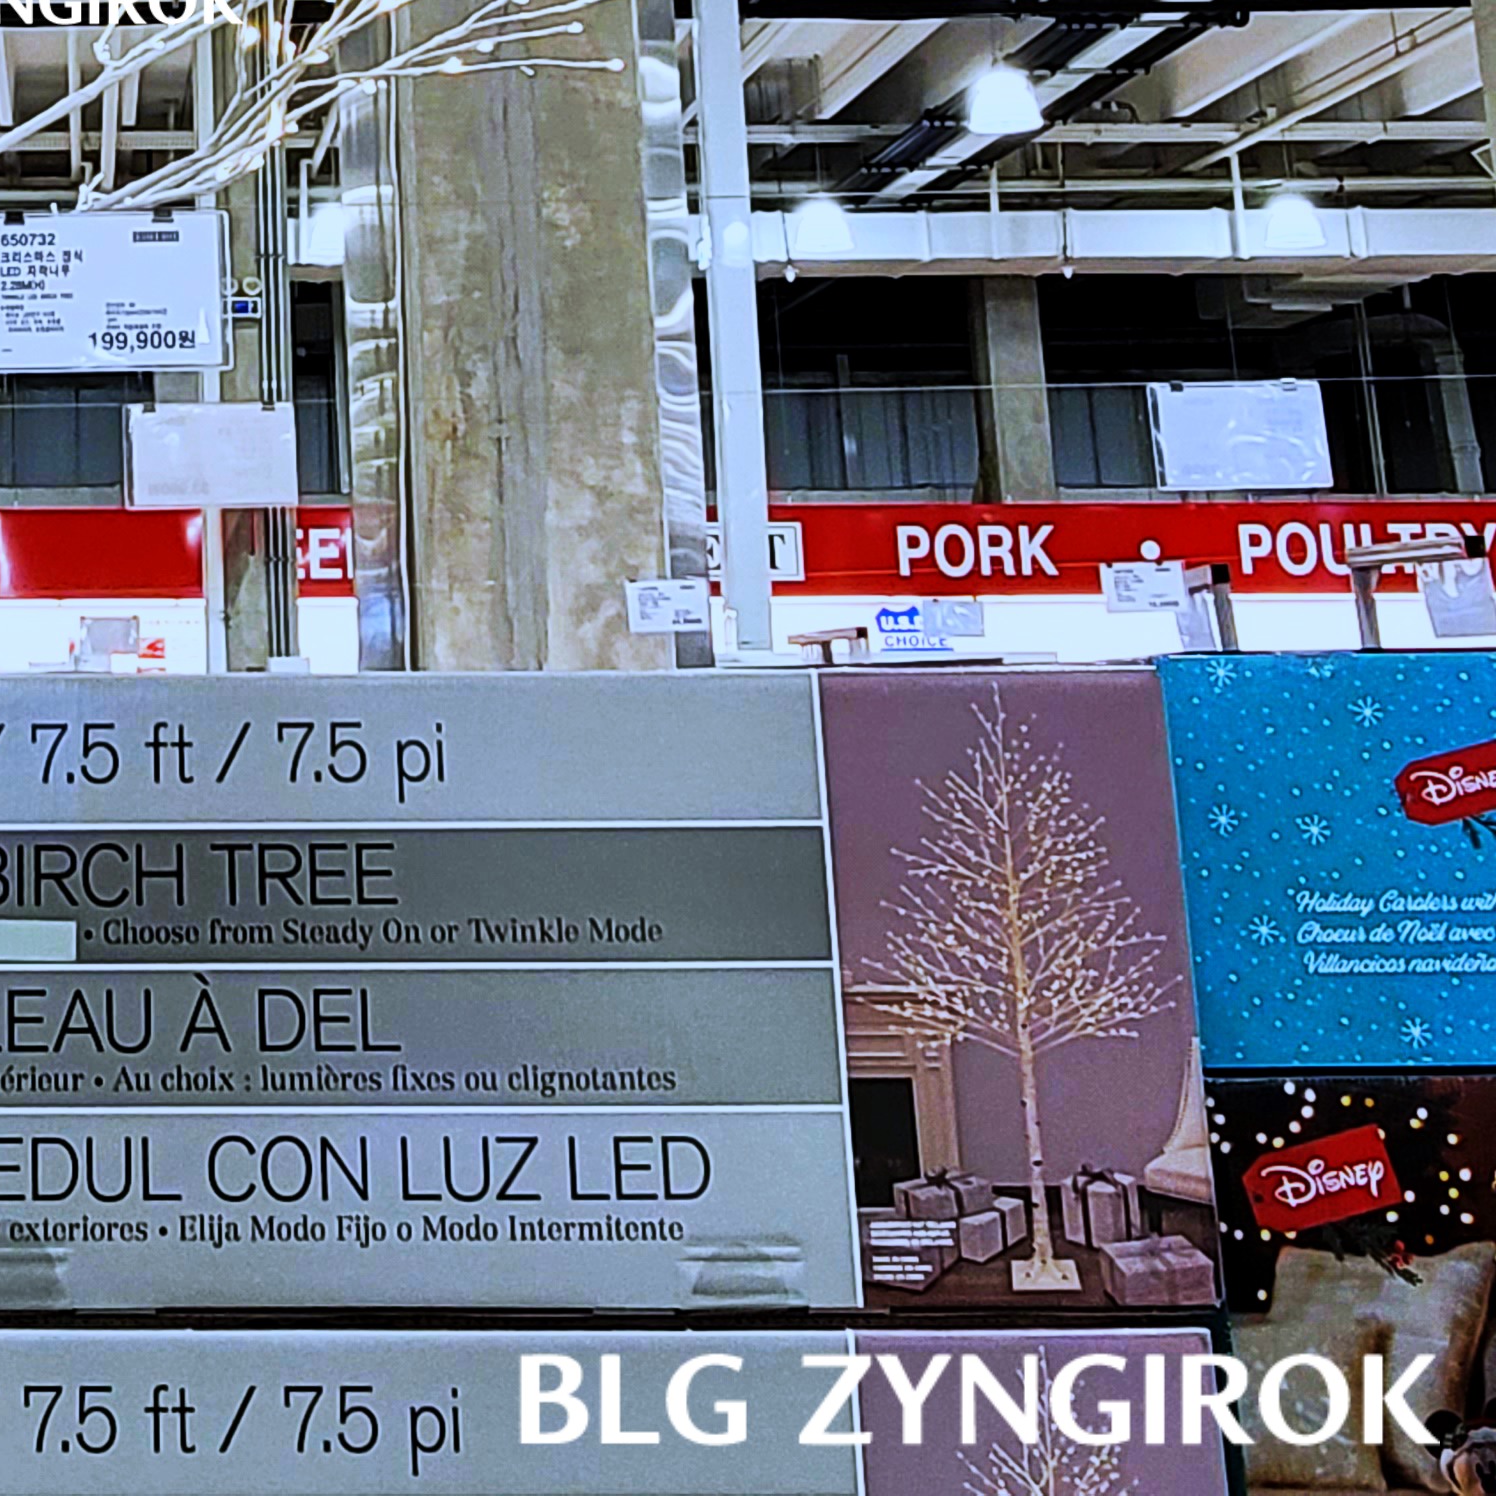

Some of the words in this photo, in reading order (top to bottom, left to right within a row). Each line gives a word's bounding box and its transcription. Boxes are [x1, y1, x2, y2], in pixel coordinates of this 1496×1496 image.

[0, 233, 56, 247] 650732
[88, 329, 196, 353] 199,900원
[896, 524, 1060, 578] PORK
[30, 721, 120, 784] 7.5
[146, 721, 194, 784] ft
[215, 721, 251, 783] /
[277, 721, 367, 784] 7.5
[397, 721, 446, 804] pi
[210, 842, 399, 906] TREE
[1296, 891, 1375, 917] Holiday
[103, 919, 200, 945] Choose
[208, 918, 277, 945] from
[282, 918, 375, 950] Steady
[382, 918, 421, 944] On
[429, 925, 460, 944] or
[468, 917, 580, 944] Twinkle
[588, 917, 664, 944] Mode
[1369, 922, 1395, 942] de
[1448, 926, 1496, 942] avec
[1303, 950, 1405, 974] Villancicos
[1408, 952, 1496, 973] navideño
[180, 972, 232, 1052] À
[257, 988, 402, 1052] DEL
[113, 1066, 152, 1092] Au
[160, 1065, 234, 1092] choix
[261, 1064, 382, 1092] lumières
[392, 1064, 455, 1091] fixes
[465, 1073, 498, 1092] ou
[508, 1064, 677, 1098] clignotantes
[208, 1135, 369, 1202] CON
[402, 1135, 541, 1202] LUZ
[568, 1135, 712, 1201] LED
[9, 1215, 149, 1242] exteriores
[178, 1214, 241, 1248] Elija
[249, 1214, 325, 1242] Modo
[335, 1214, 387, 1248] Fijo
[396, 1222, 413, 1242] o
[422, 1214, 498, 1242] Modo
[507, 1214, 684, 1242] Intermitente
[23, 1385, 118, 1454] 7.5
[144, 1384, 196, 1454] ft
[218, 1385, 257, 1454] /
[283, 1385, 379, 1454] 7.5
[409, 1387, 461, 1477] pi
